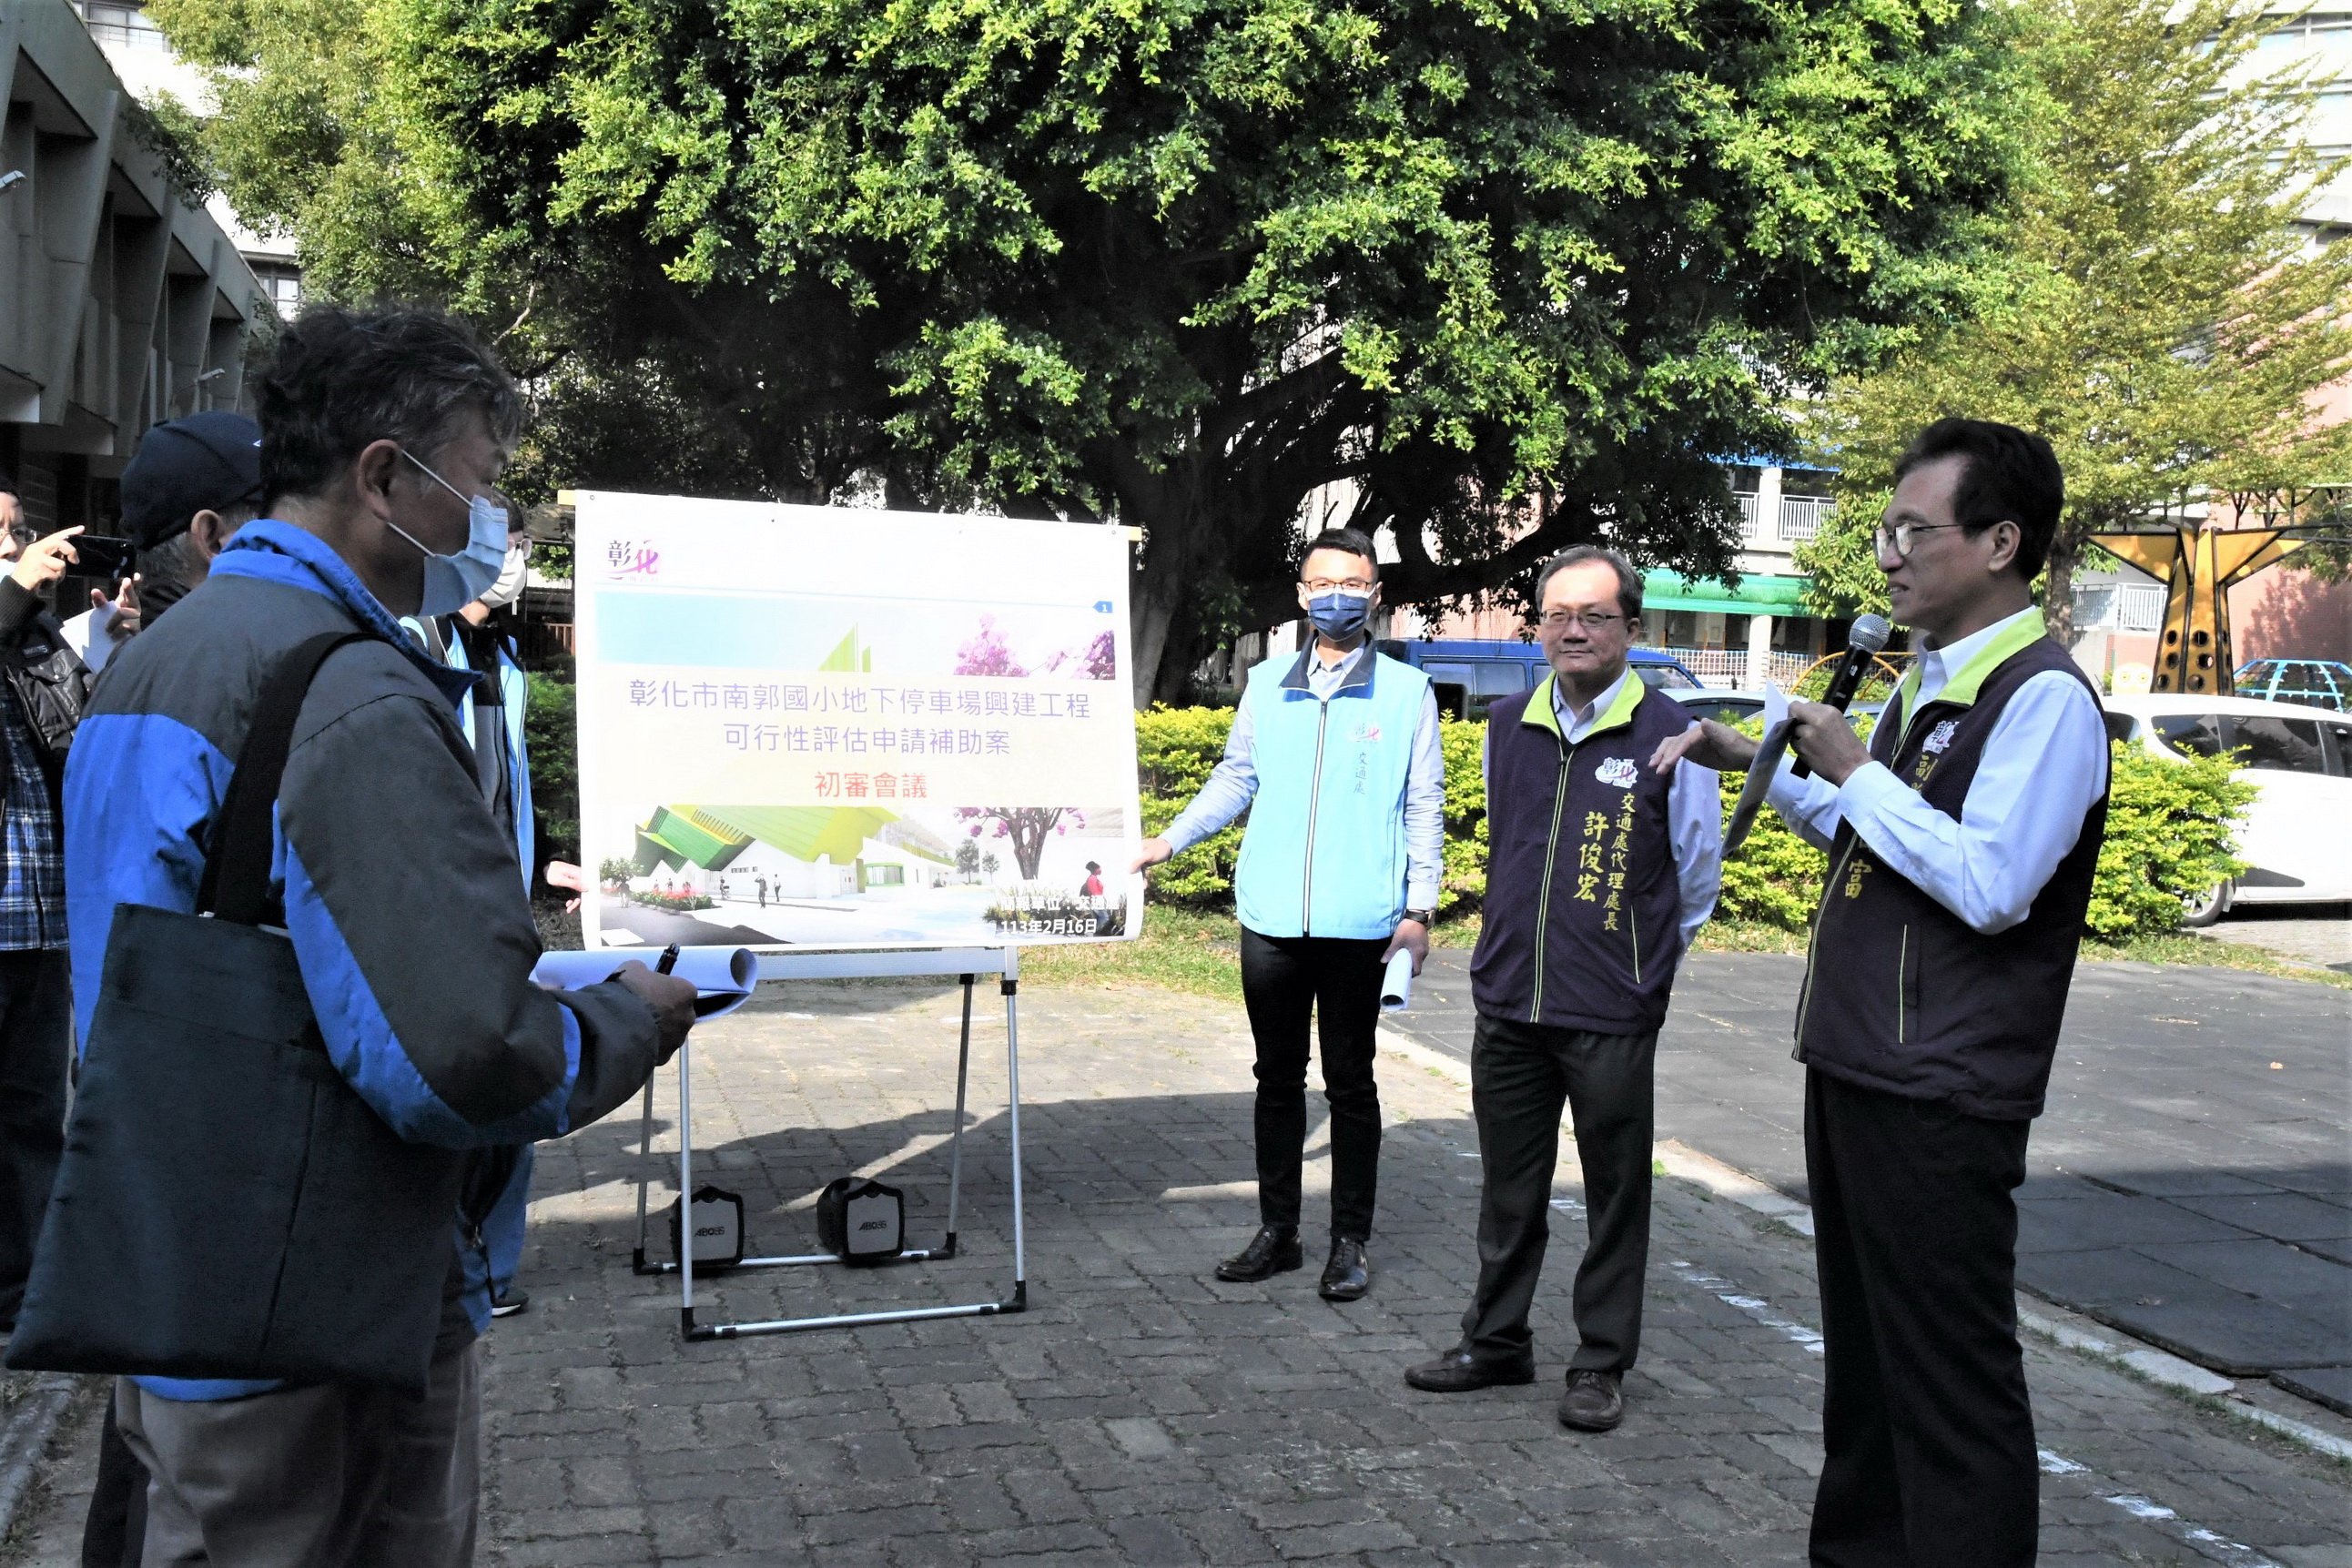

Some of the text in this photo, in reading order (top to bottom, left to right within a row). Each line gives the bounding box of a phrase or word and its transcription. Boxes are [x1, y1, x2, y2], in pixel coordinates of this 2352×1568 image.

[606, 540, 659, 575] 彰化
[629, 679, 1091, 719] 彰化市南郭國小地下停車場興建工程
[724, 723, 1011, 755] 可行性評估申請補助案
[815, 771, 928, 799] 初審會議
[1573, 810, 1610, 903] 許俊宏
[1603, 792, 1637, 932] 交通處代理處長
[1001, 918, 1098, 935] 113年2月16日
